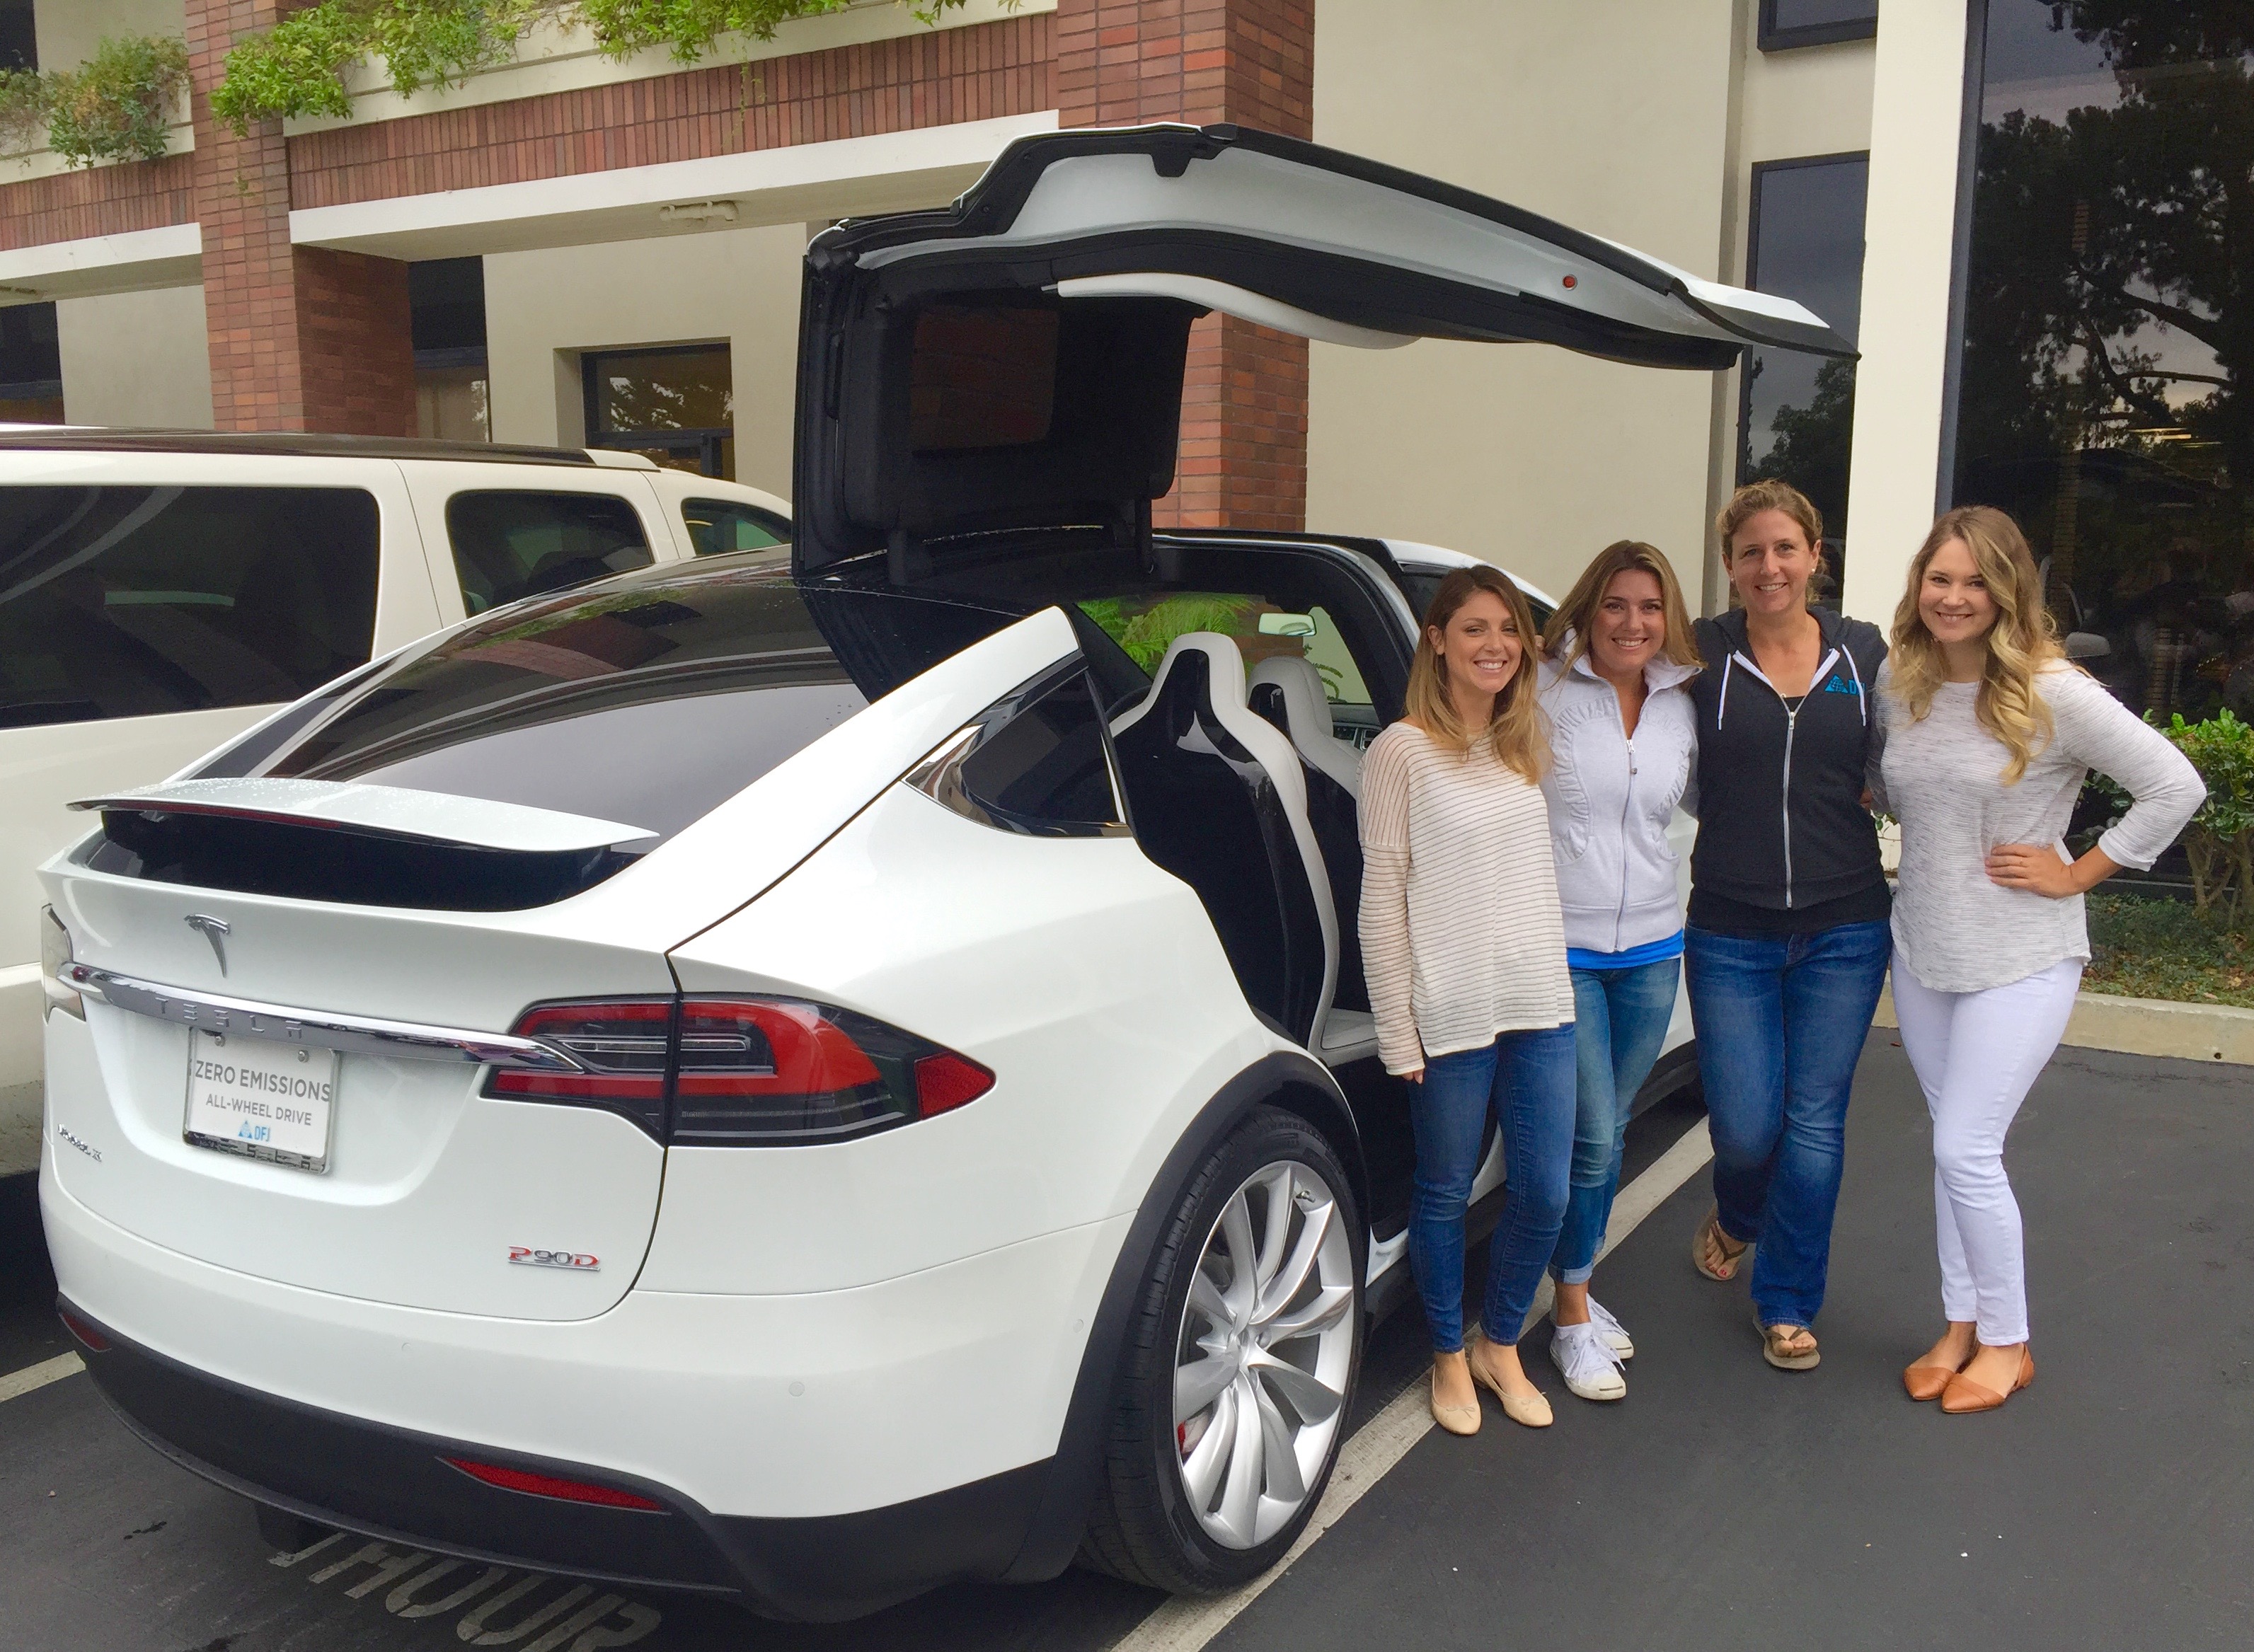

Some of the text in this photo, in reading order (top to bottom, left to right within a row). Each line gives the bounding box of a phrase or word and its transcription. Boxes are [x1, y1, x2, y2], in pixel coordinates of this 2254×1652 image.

[155, 997, 302, 1039] TESLA
[195, 1060, 330, 1102] ZERO EMISSIONS
[205, 1093, 312, 1126] ALL-WHEEL DRIVE
[254, 1126, 271, 1142] DFJ
[508, 1245, 600, 1267] P90D
